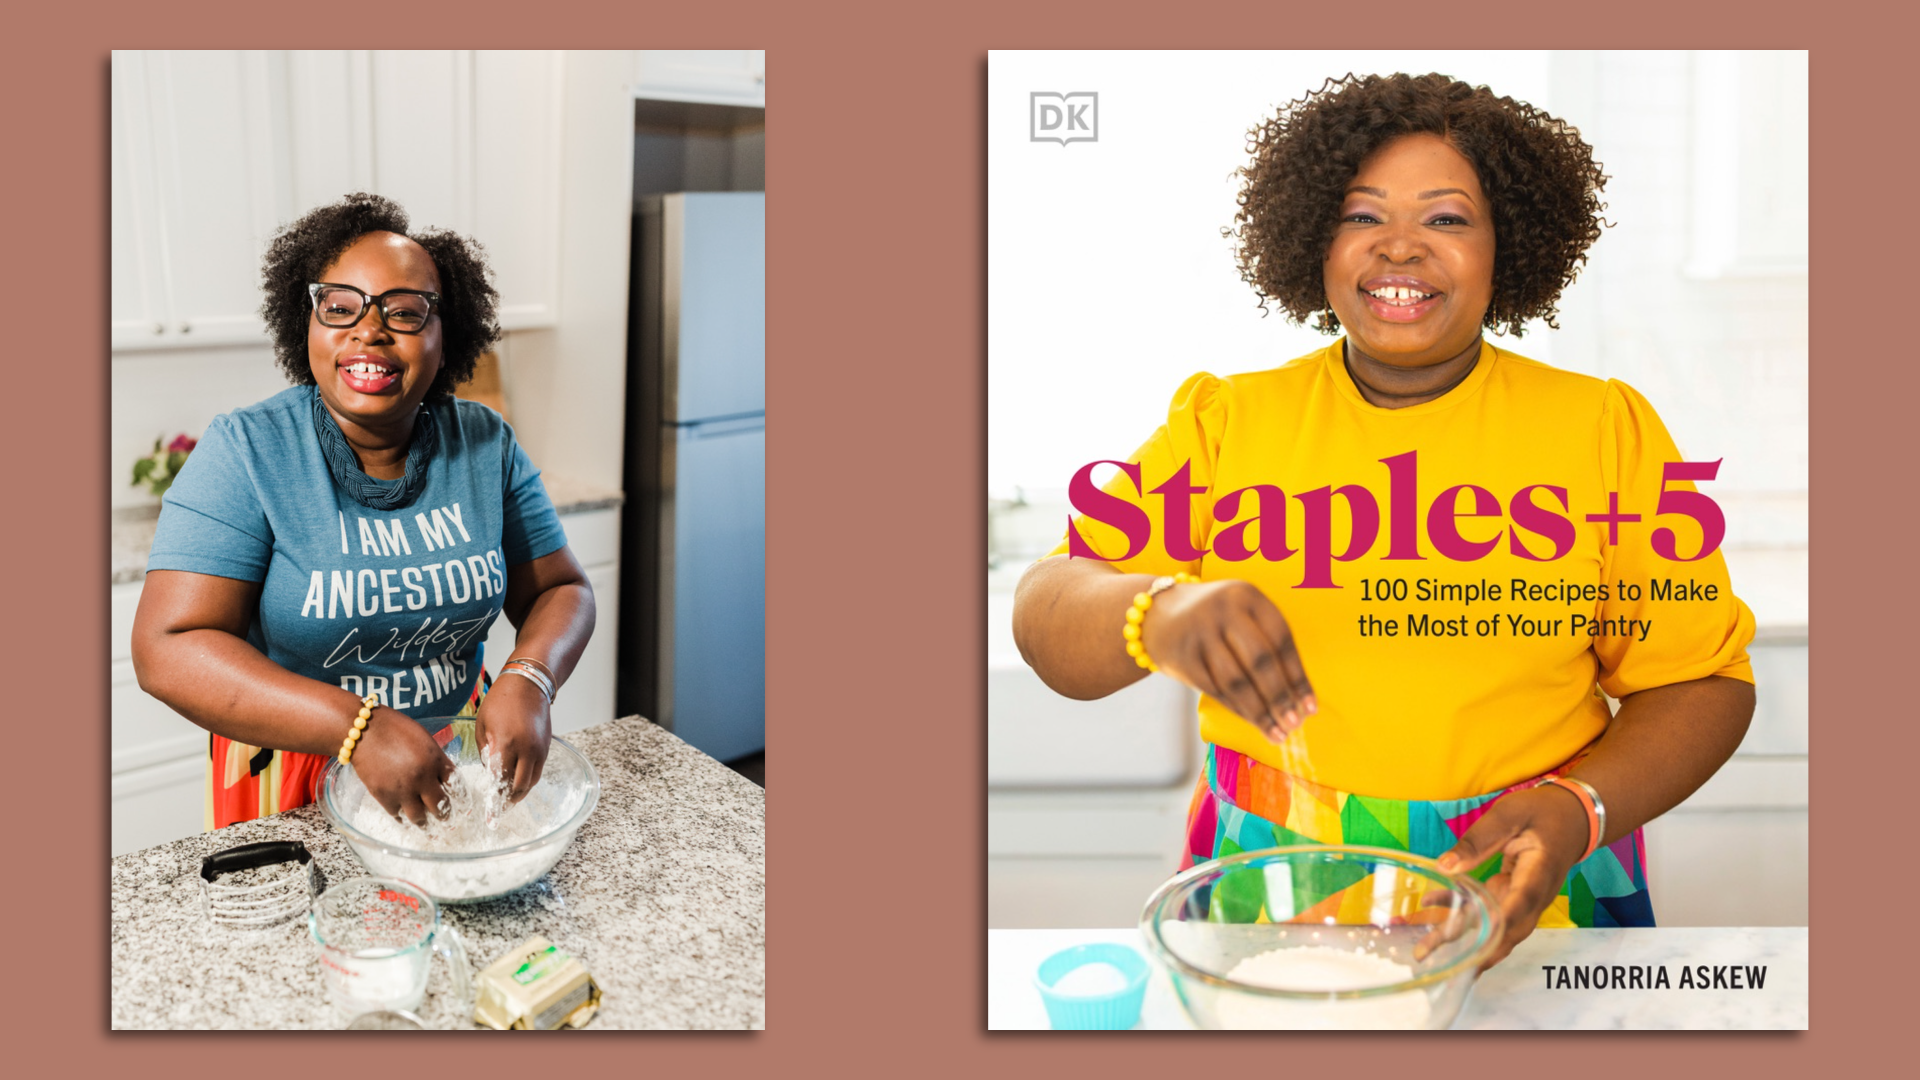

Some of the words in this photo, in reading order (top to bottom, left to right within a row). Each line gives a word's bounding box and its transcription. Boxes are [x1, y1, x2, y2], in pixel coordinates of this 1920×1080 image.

[1040, 104, 1090, 130] DK
[339, 510, 349, 554] I
[358, 517, 412, 556] AM
[415, 503, 471, 552] MY
[1068, 450, 1726, 589] Staples+5
[1360, 578, 1408, 601] 100
[1416, 578, 1502, 606] Simple
[1511, 578, 1610, 606] Recipes
[1617, 579, 1642, 601] to
[1651, 578, 1719, 601] Make
[323, 608, 501, 668] Wildest
[1358, 614, 1398, 637] the
[1408, 614, 1468, 637] Most
[1476, 614, 1500, 637] of
[1507, 614, 1563, 637] Your
[1571, 614, 1652, 641] Pantry
[1541, 965, 1671, 990] TANORRIA
[1678, 965, 1768, 990] ASKEW
